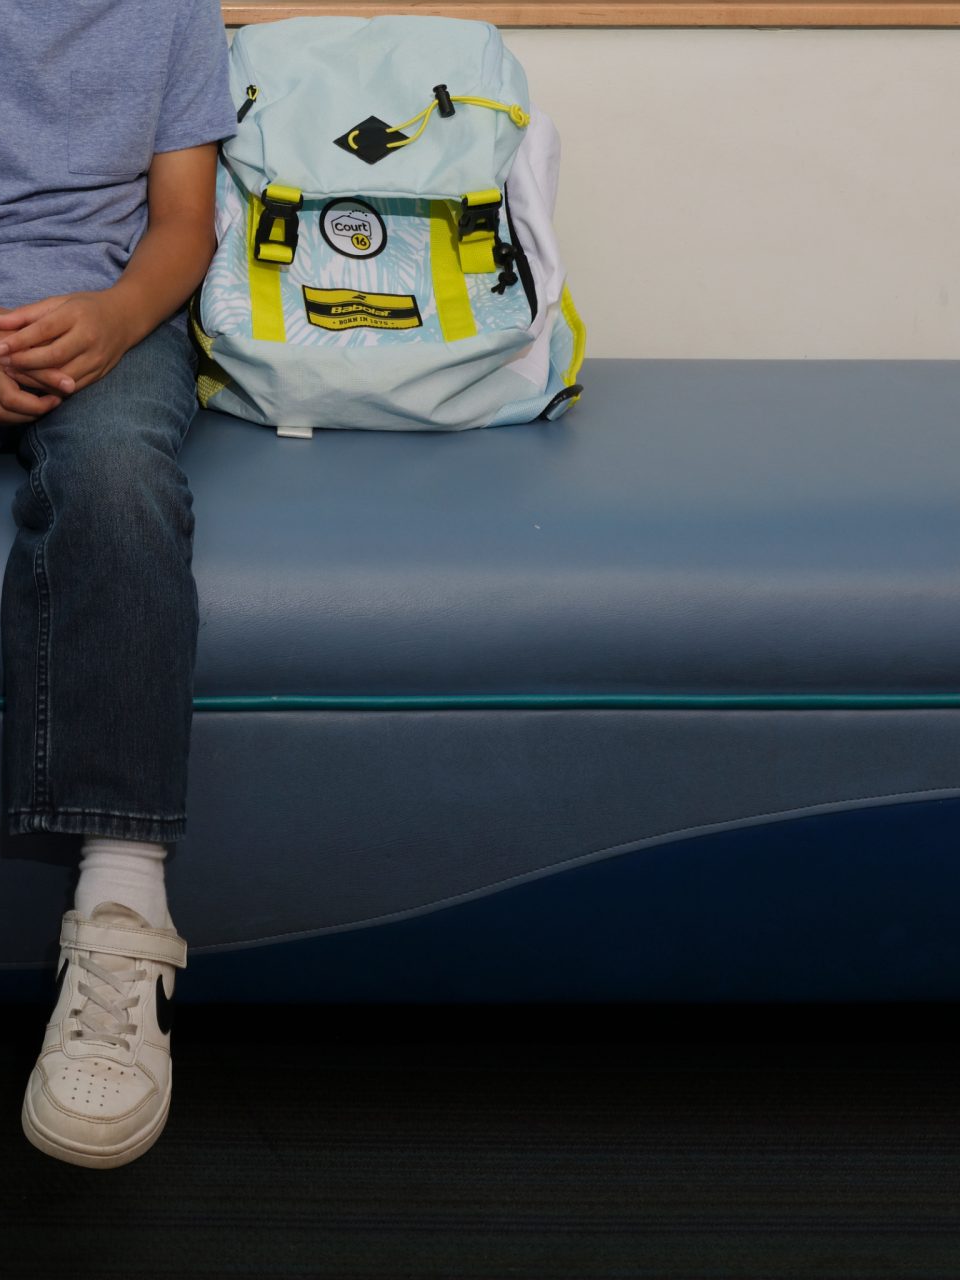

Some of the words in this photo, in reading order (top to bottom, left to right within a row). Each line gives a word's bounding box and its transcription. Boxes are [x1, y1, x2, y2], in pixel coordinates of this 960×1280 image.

[334, 222, 369, 232] Court
[354, 236, 367, 247] 16
[331, 304, 391, 317] Babolat
